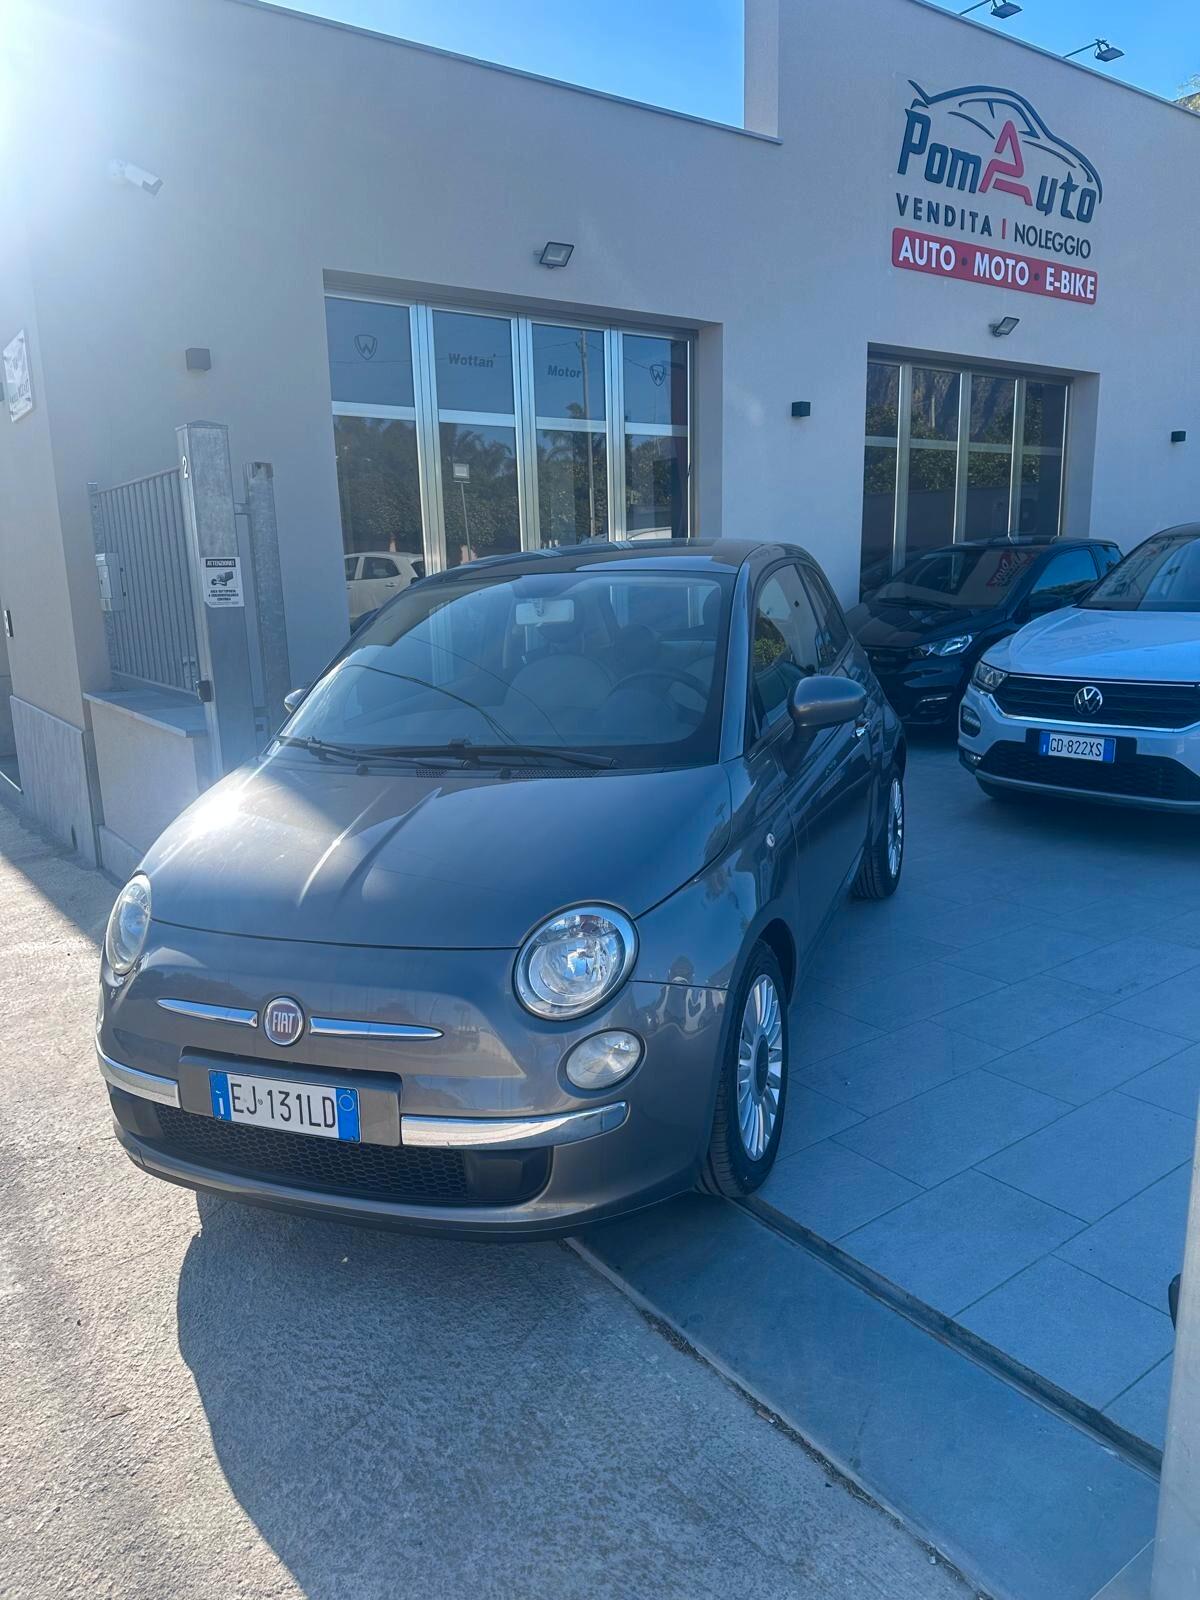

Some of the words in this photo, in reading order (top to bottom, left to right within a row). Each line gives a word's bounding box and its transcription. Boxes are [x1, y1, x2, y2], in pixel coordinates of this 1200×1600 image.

[896, 192, 993, 237] VENDITA
[1014, 222, 1092, 259] NOLEGGIO
[898, 236, 956, 271] AUTO
[973, 251, 1030, 286] MOTO
[1045, 266, 1096, 299] E-BIKE
[547, 364, 582, 379] Motor
[182, 455, 189, 479] 2
[272, 1010, 296, 1034] FIAT
